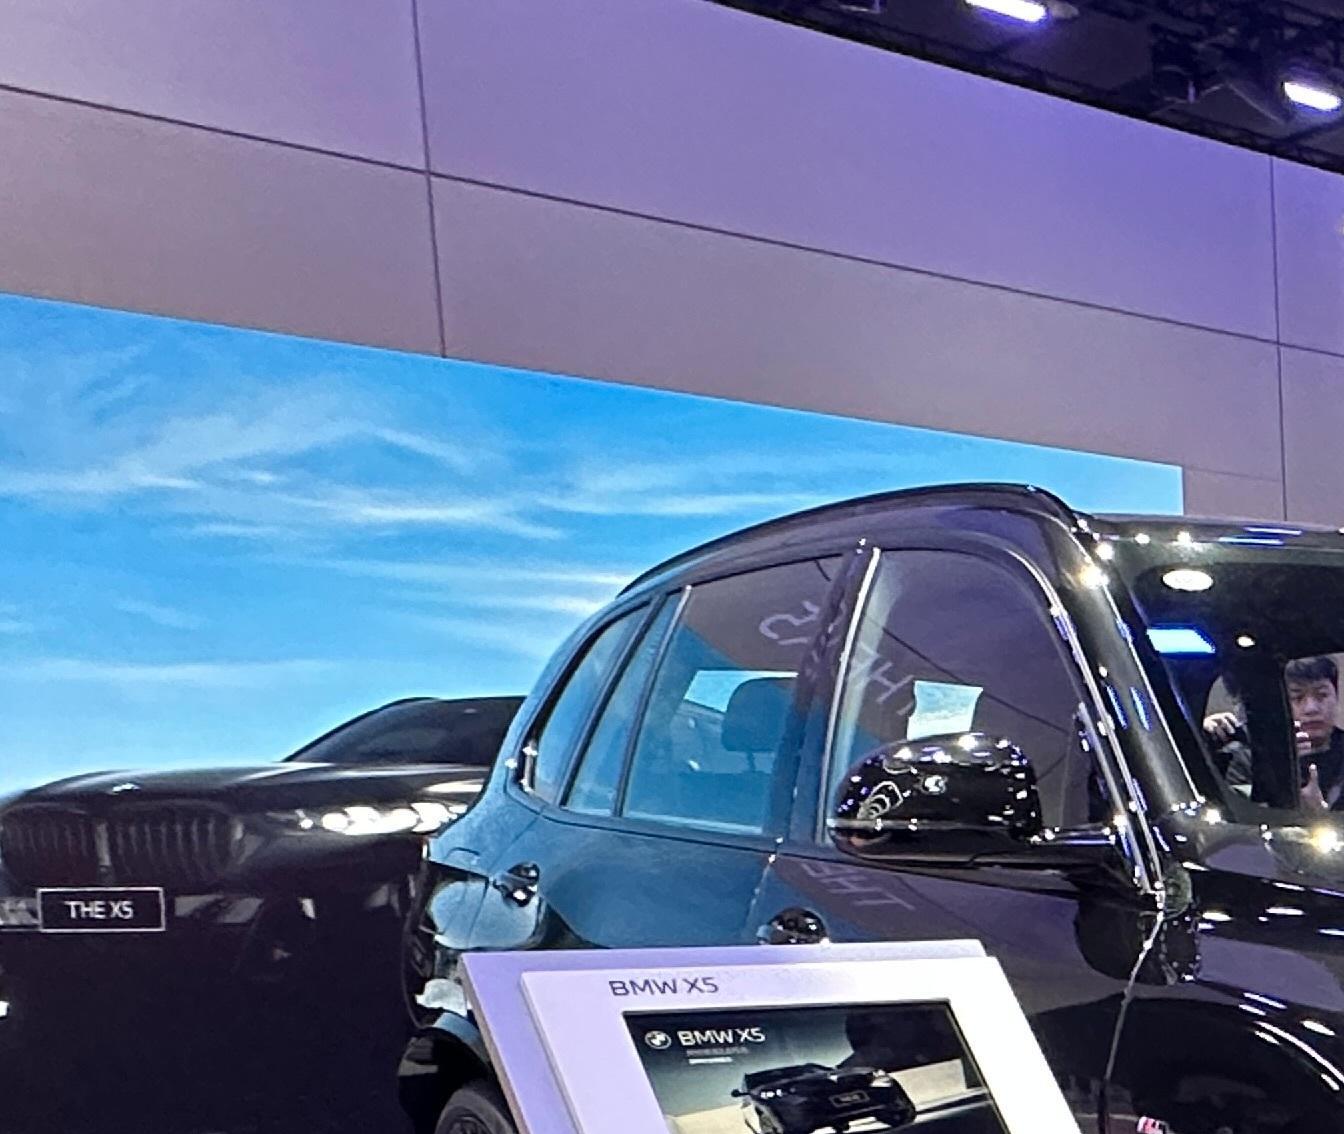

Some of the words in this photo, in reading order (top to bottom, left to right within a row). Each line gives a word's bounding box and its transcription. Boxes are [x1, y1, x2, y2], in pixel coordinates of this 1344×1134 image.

[64, 900, 106, 919] THE
[110, 900, 134, 920] X5
[608, 979, 678, 996] BMW
[682, 976, 719, 994] X5
[676, 1029, 734, 1047] BMW
[736, 1026, 766, 1043] X5
